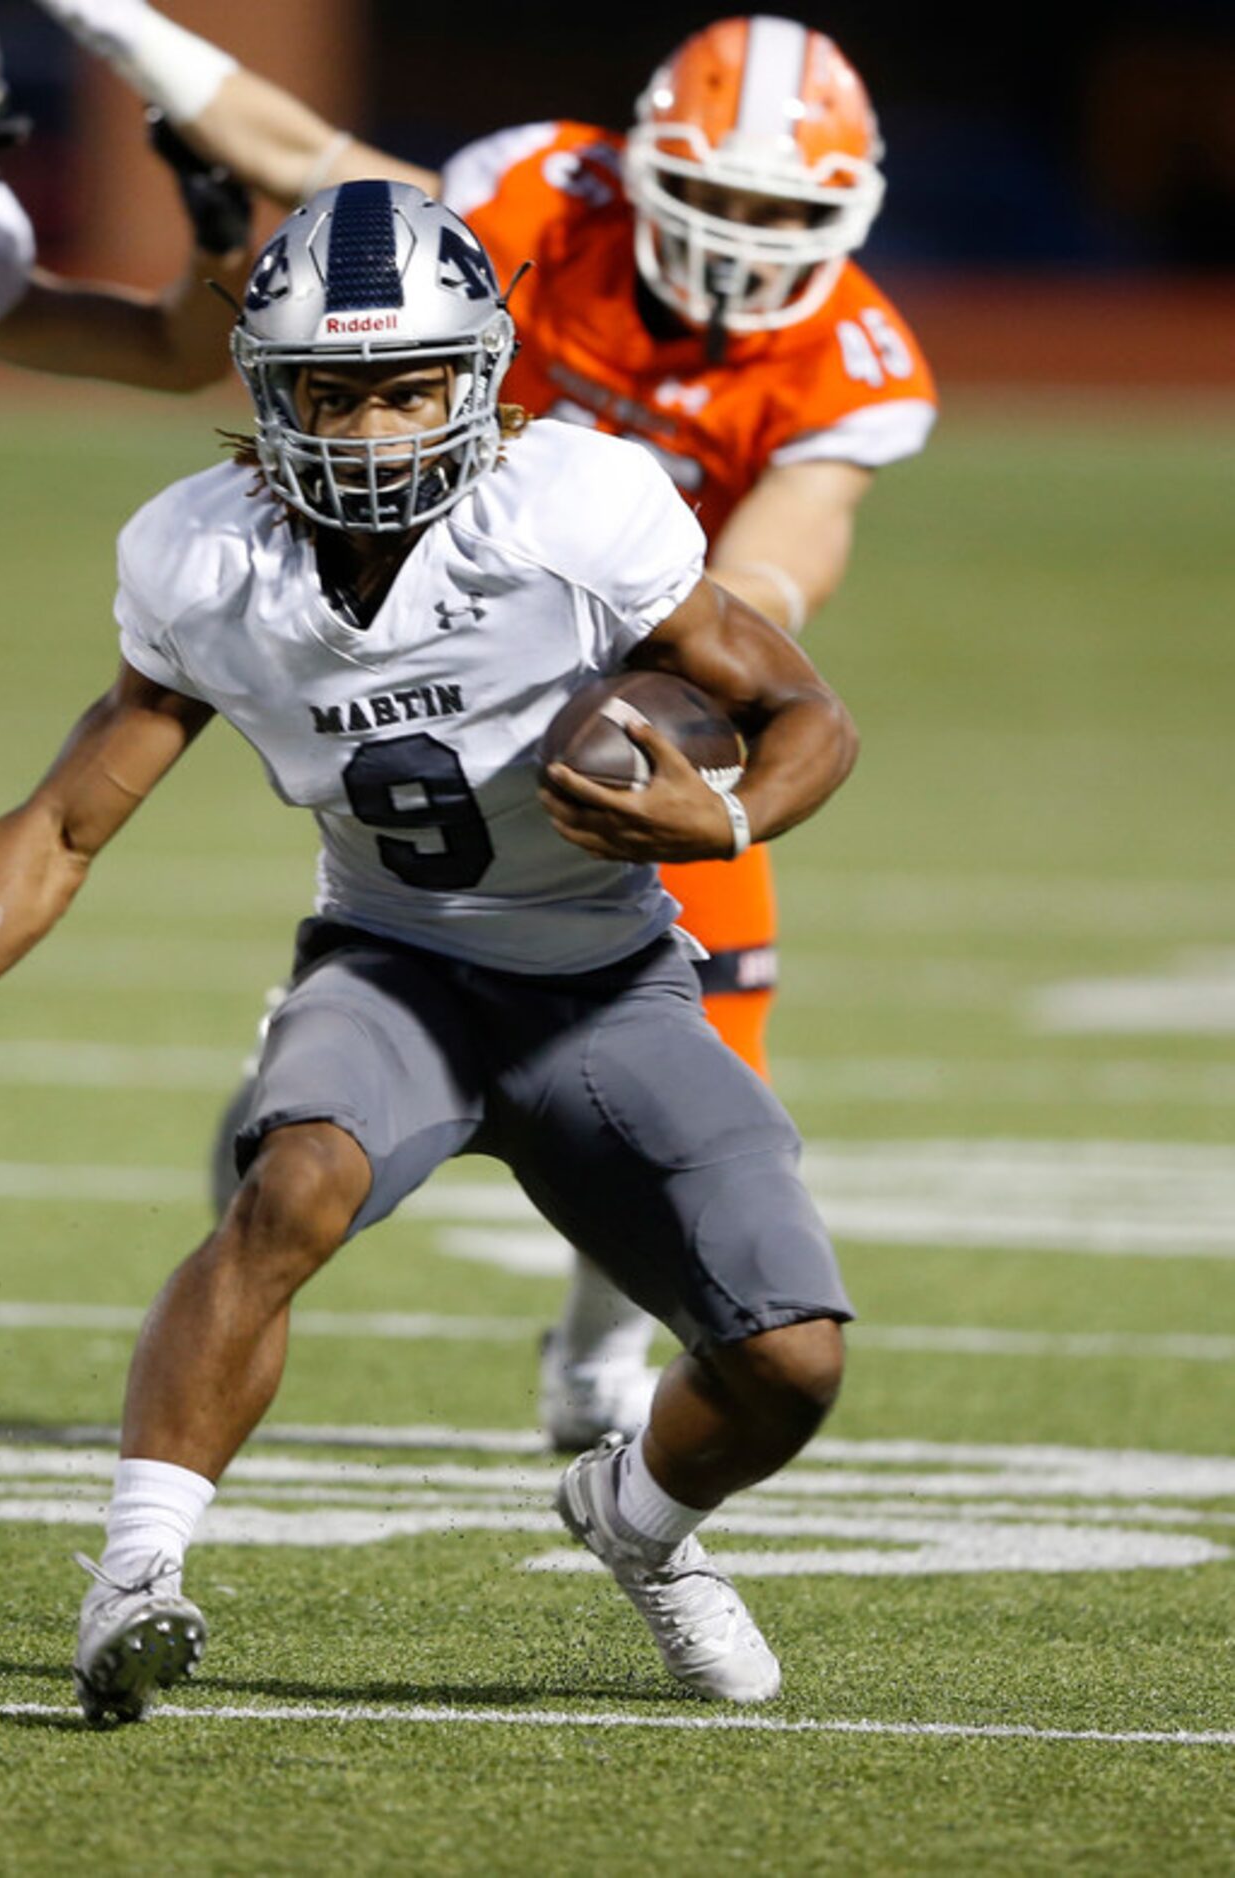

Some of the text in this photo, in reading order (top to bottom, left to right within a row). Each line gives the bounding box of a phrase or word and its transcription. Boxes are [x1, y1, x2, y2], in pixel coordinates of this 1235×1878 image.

[326, 314, 398, 334] Riddell
[836, 306, 914, 389] 45
[309, 683, 466, 734] MARTIN
[341, 730, 496, 892] 9
